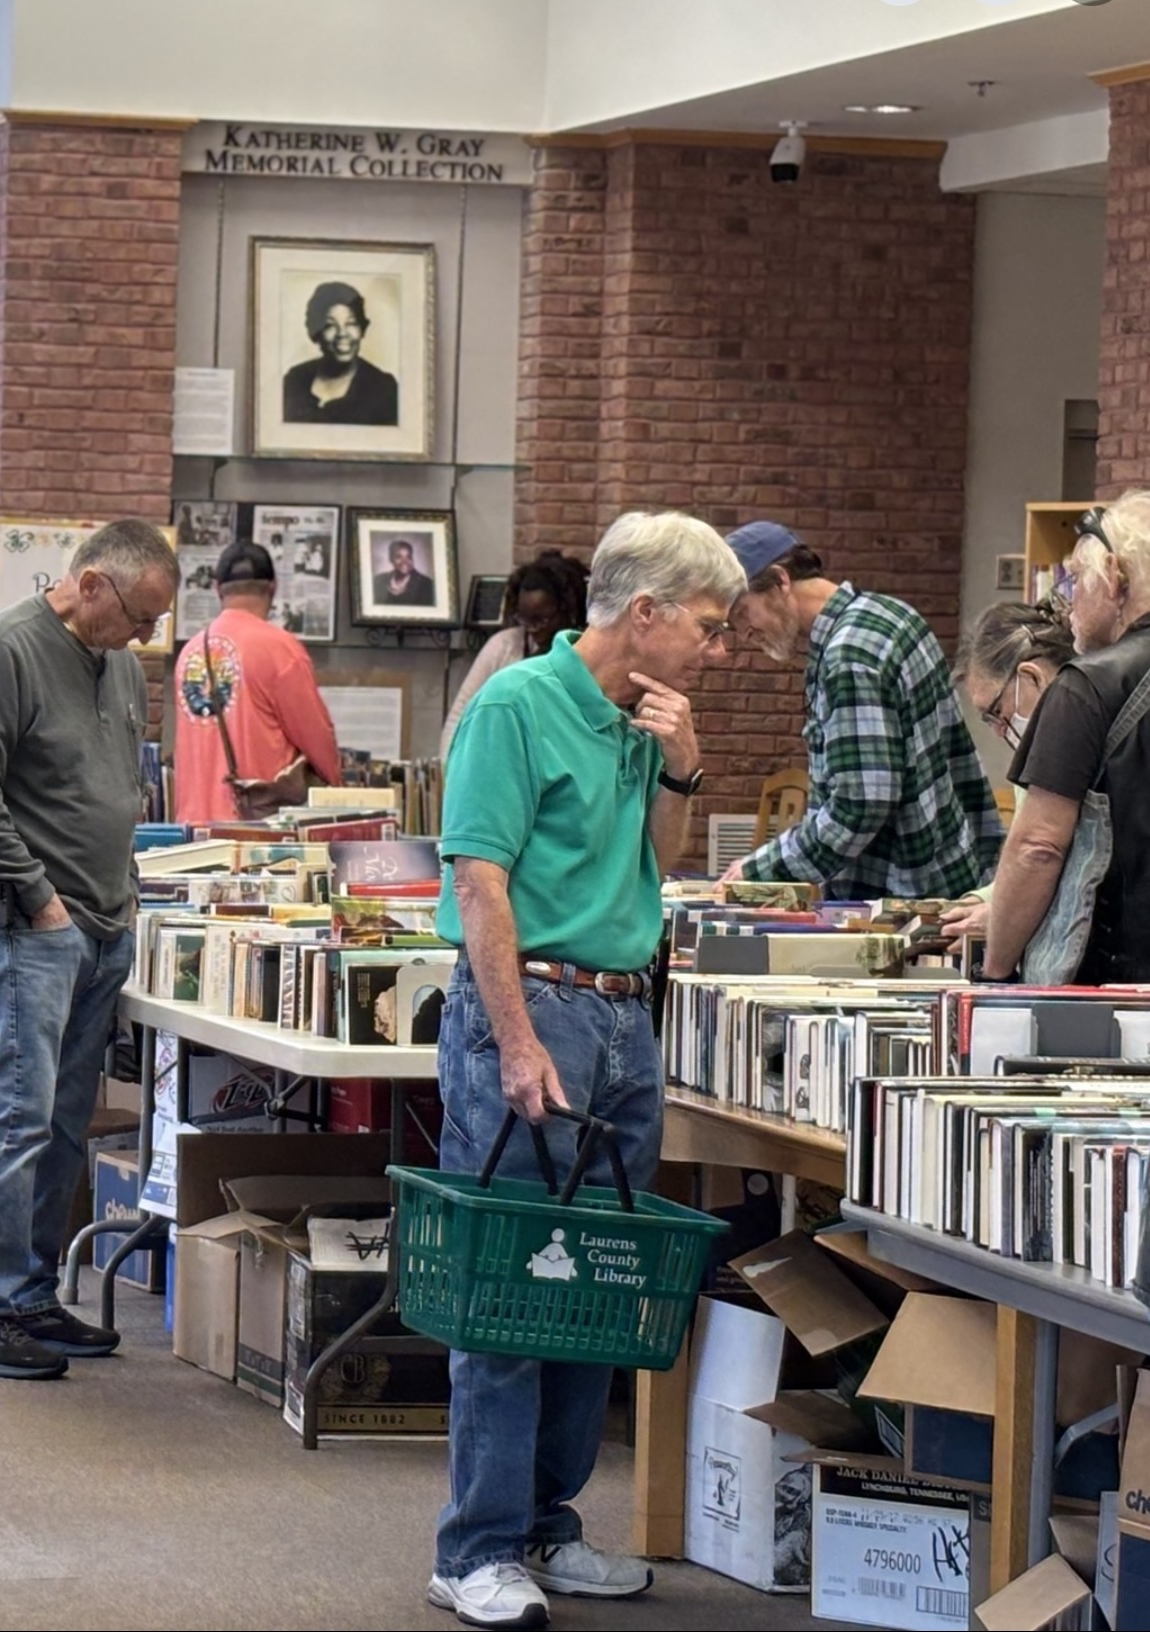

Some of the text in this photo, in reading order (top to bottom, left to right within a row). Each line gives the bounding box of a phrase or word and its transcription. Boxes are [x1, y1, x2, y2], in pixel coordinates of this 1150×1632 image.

[223, 125, 486, 157] KATHERINE W. GRAY
[204, 149, 504, 181] MEMORIAL COLLECTION
[579, 1231, 637, 1251] Laurens
[587, 1248, 641, 1271] County
[594, 1267, 647, 1290] Library
[324, 1413, 365, 1424] SINCE
[837, 1466, 869, 1480] JACK
[864, 1548, 922, 1575] 4796000
